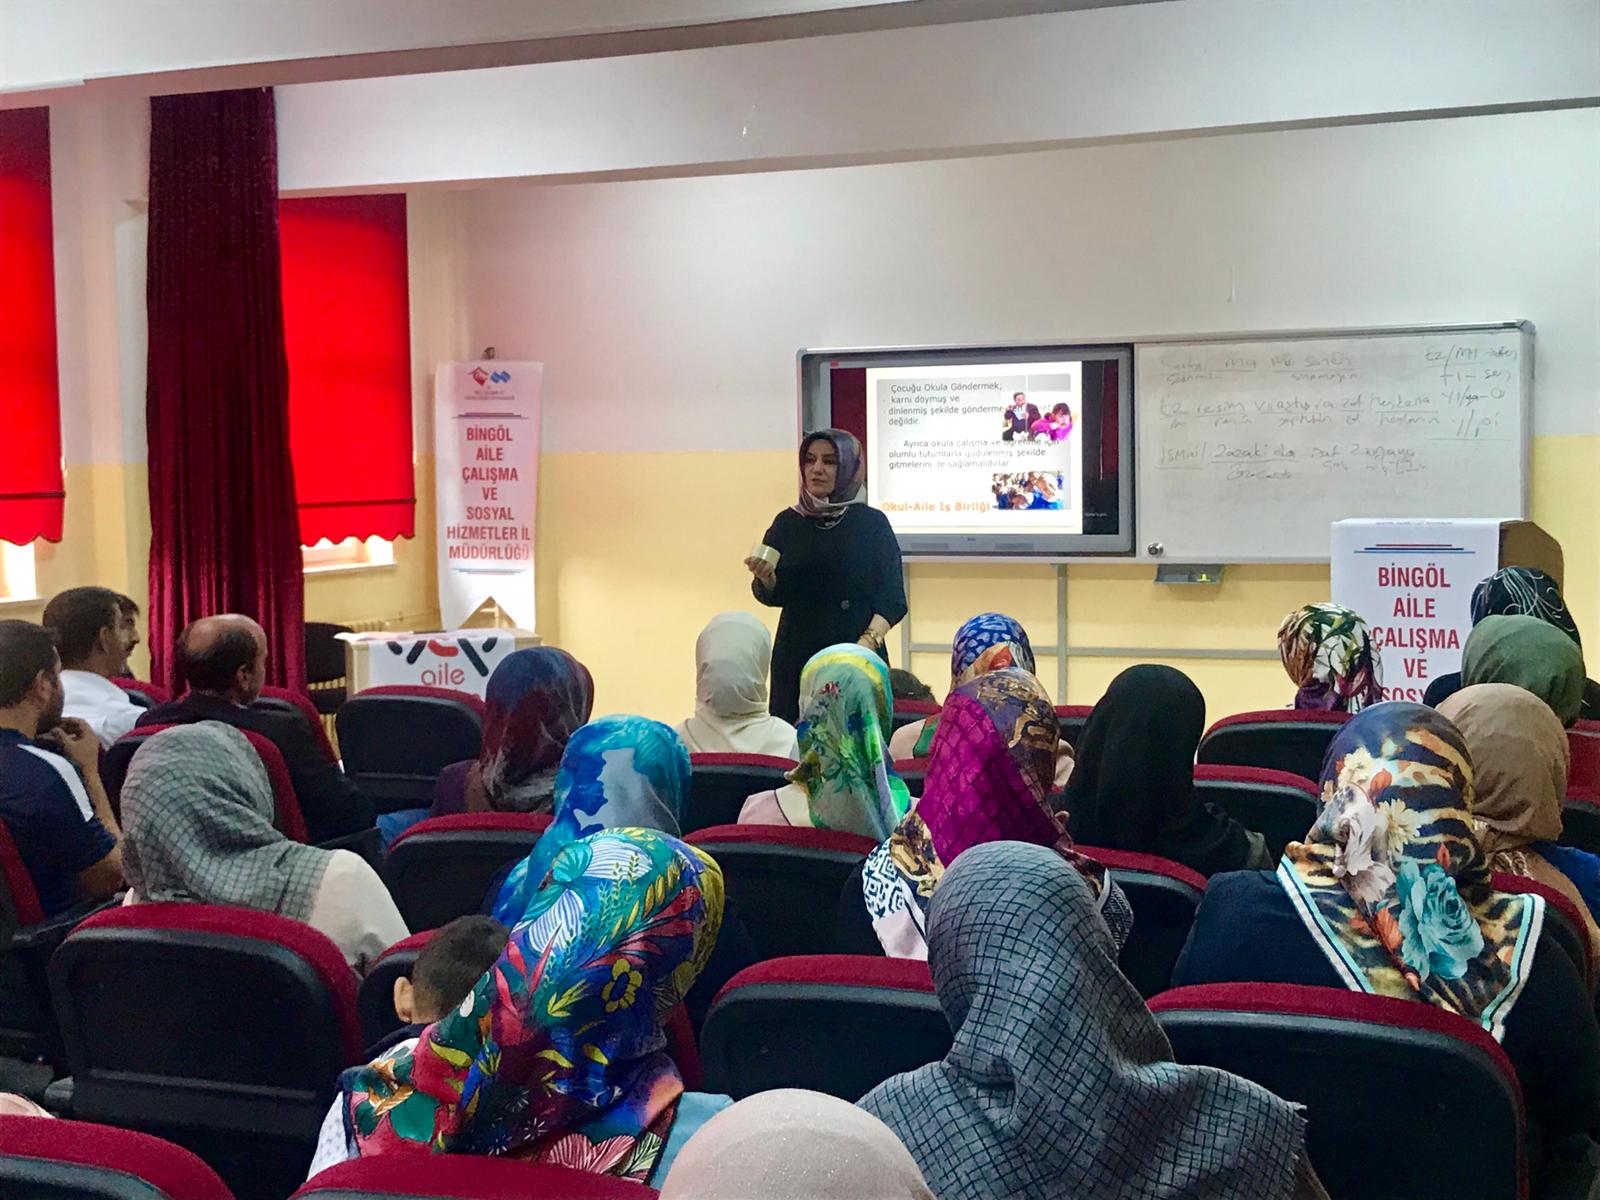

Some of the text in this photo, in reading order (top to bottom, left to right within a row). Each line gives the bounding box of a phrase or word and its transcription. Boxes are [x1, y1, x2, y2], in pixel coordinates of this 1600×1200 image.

[890, 381, 1003, 394] Çocuğu Okula Göndermek;
[891, 395, 912, 404] karnı
[914, 395, 947, 405] doymuş
[888, 407, 928, 416] dinlenmiş
[930, 405, 959, 415] şekilde
[466, 424, 513, 441] BİNGÖL
[903, 440, 929, 449] Ayrıca
[931, 439, 954, 448] okula
[956, 439, 988, 449] çalışma
[476, 445, 503, 461] AİLE
[888, 450, 917, 459] olumlu
[1016, 448, 1047, 458] şekilde
[888, 460, 933, 470] gitmelerini
[462, 467, 518, 484] ÇALIŞMA
[482, 487, 498, 501] VE
[466, 506, 514, 521] SOSYAL
[881, 500, 990, 513] Okul-Aile İş Birliği
[446, 523, 531, 541] HİZMETLER İL
[449, 543, 529, 560] MÜDÜRLÜĞÜ
[1378, 562, 1451, 588] BİNGÖL
[1393, 592, 1435, 618] AİLE
[1372, 626, 1460, 654] ÇALIŞMA
[421, 662, 465, 685] aile
[1403, 658, 1428, 678] VE
